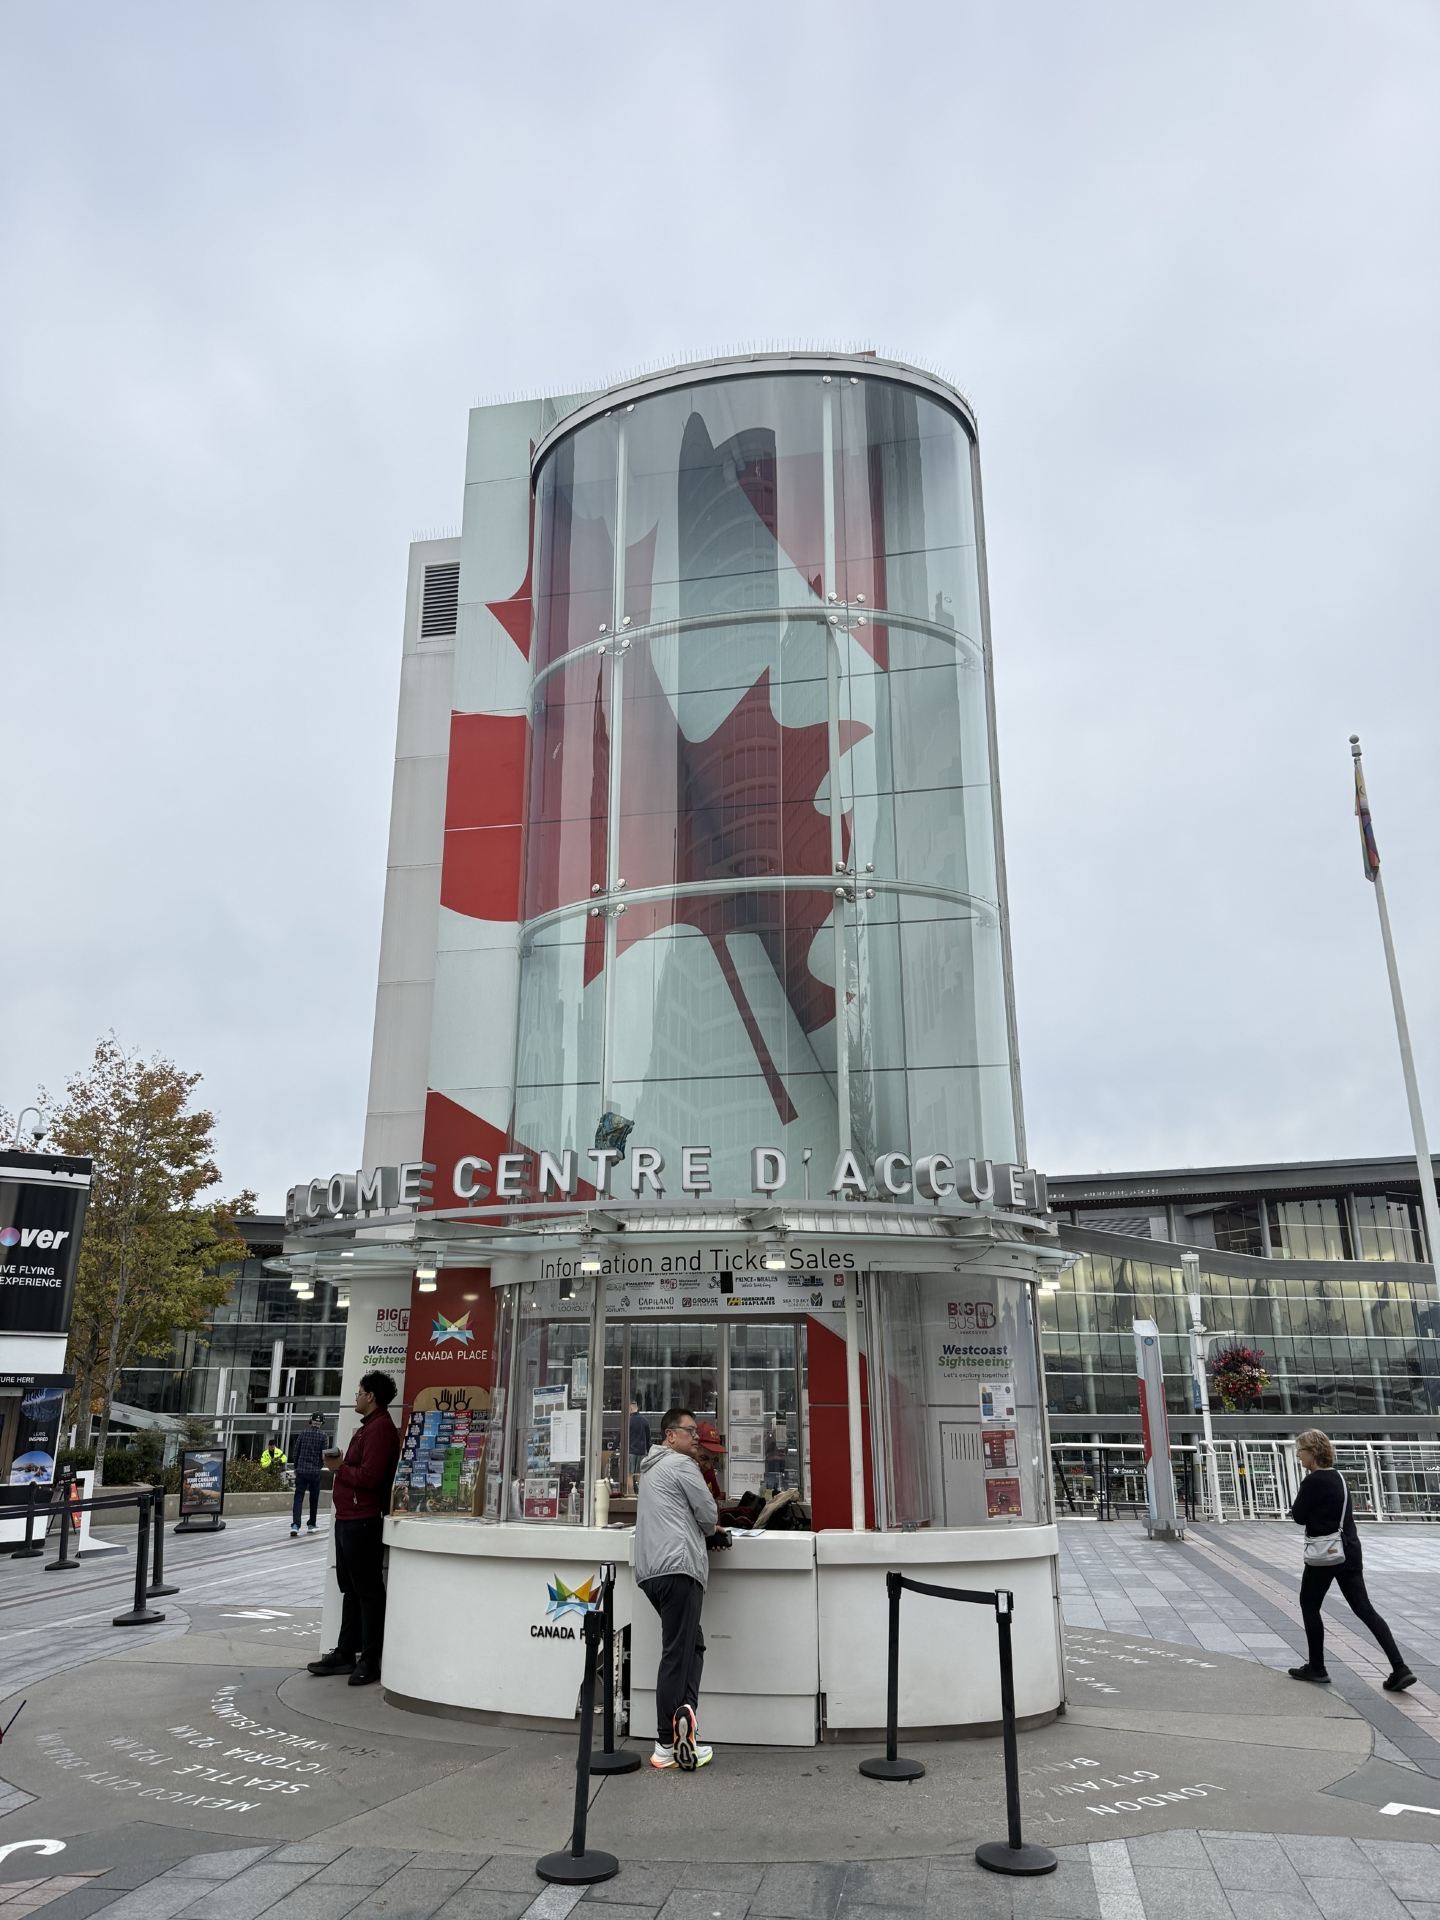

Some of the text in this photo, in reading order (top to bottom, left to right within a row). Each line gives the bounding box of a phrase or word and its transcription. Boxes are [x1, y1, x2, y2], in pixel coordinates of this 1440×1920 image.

[453, 1146, 712, 1198] CENTRE
[660, 1249, 701, 1272] and
[710, 1248, 780, 1270] Ticke
[790, 1248, 855, 1269] Sales
[19, 1265, 55, 1275] FLYING
[0, 1276, 62, 1288] EXPERIENCE
[638, 1297, 675, 1306] CAPILANO
[377, 1308, 398, 1320] BIG
[947, 1302, 975, 1316] BIG
[376, 1321, 398, 1333] BUS
[948, 1316, 976, 1330] BUS
[414, 1350, 488, 1361] CANADA PLACE
[942, 1345, 1008, 1355] Westcoast
[938, 1356, 1014, 1369] Sightseeing
[530, 1625, 575, 1640] CANADA
[165, 1724, 203, 1739] KM
[194, 1737, 224, 1749] 92
[128, 1748, 174, 1766] 192
[78, 1771, 142, 1791] CITY
[171, 1763, 310, 1794] SEATTLE
[1021, 1770, 1160, 1799] OTTAWA
[137, 1787, 261, 1813] MEXICO
[1084, 1783, 1227, 1816] LONDON
